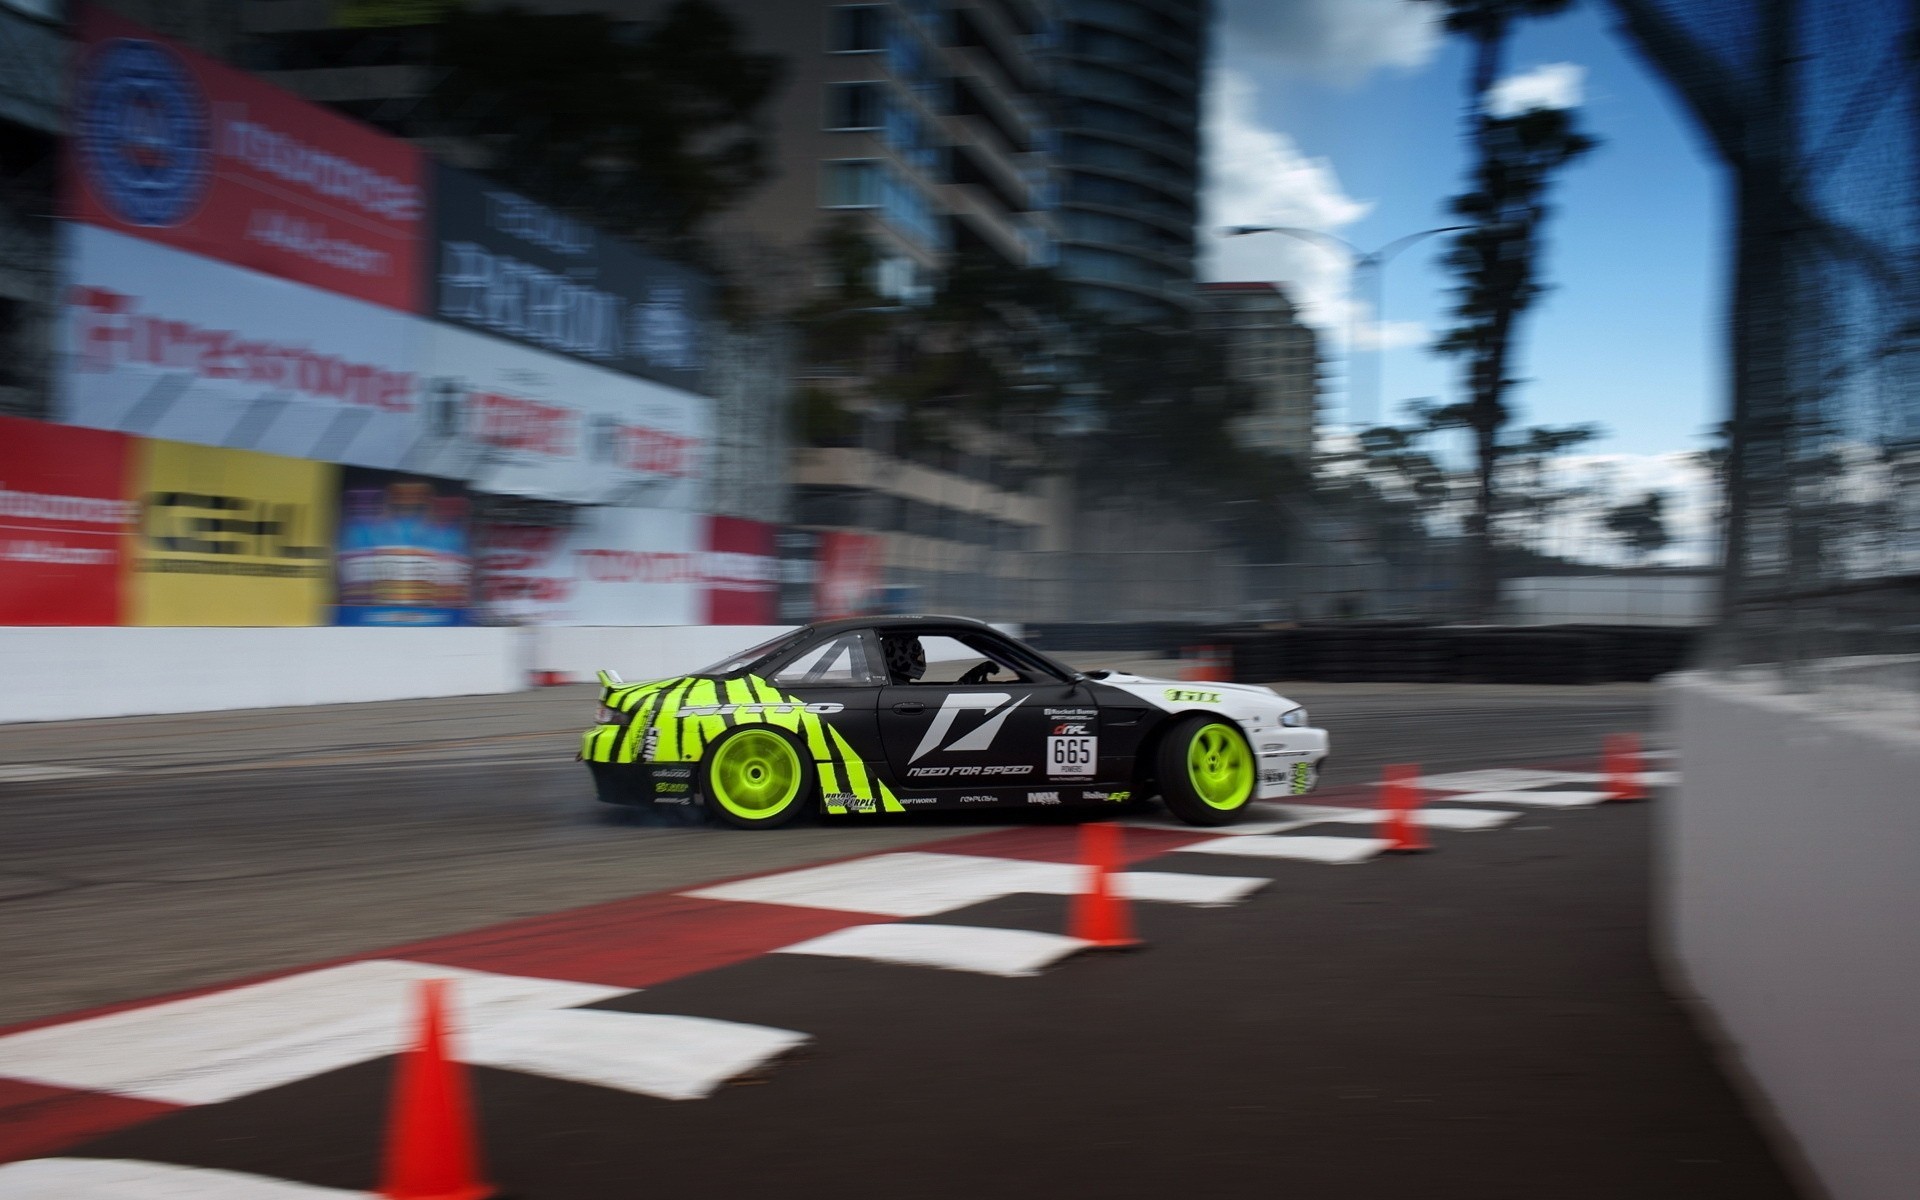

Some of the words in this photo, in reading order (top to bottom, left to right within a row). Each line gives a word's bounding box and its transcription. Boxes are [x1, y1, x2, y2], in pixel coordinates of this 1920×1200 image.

[68, 284, 416, 413] Firestone
[675, 702, 845, 718] NITTO
[1054, 739, 1090, 764] 665
[907, 766, 947, 777] NEED
[949, 766, 981, 776] FOR
[983, 765, 1034, 776] SPEED
[843, 798, 877, 807] PURPLE
